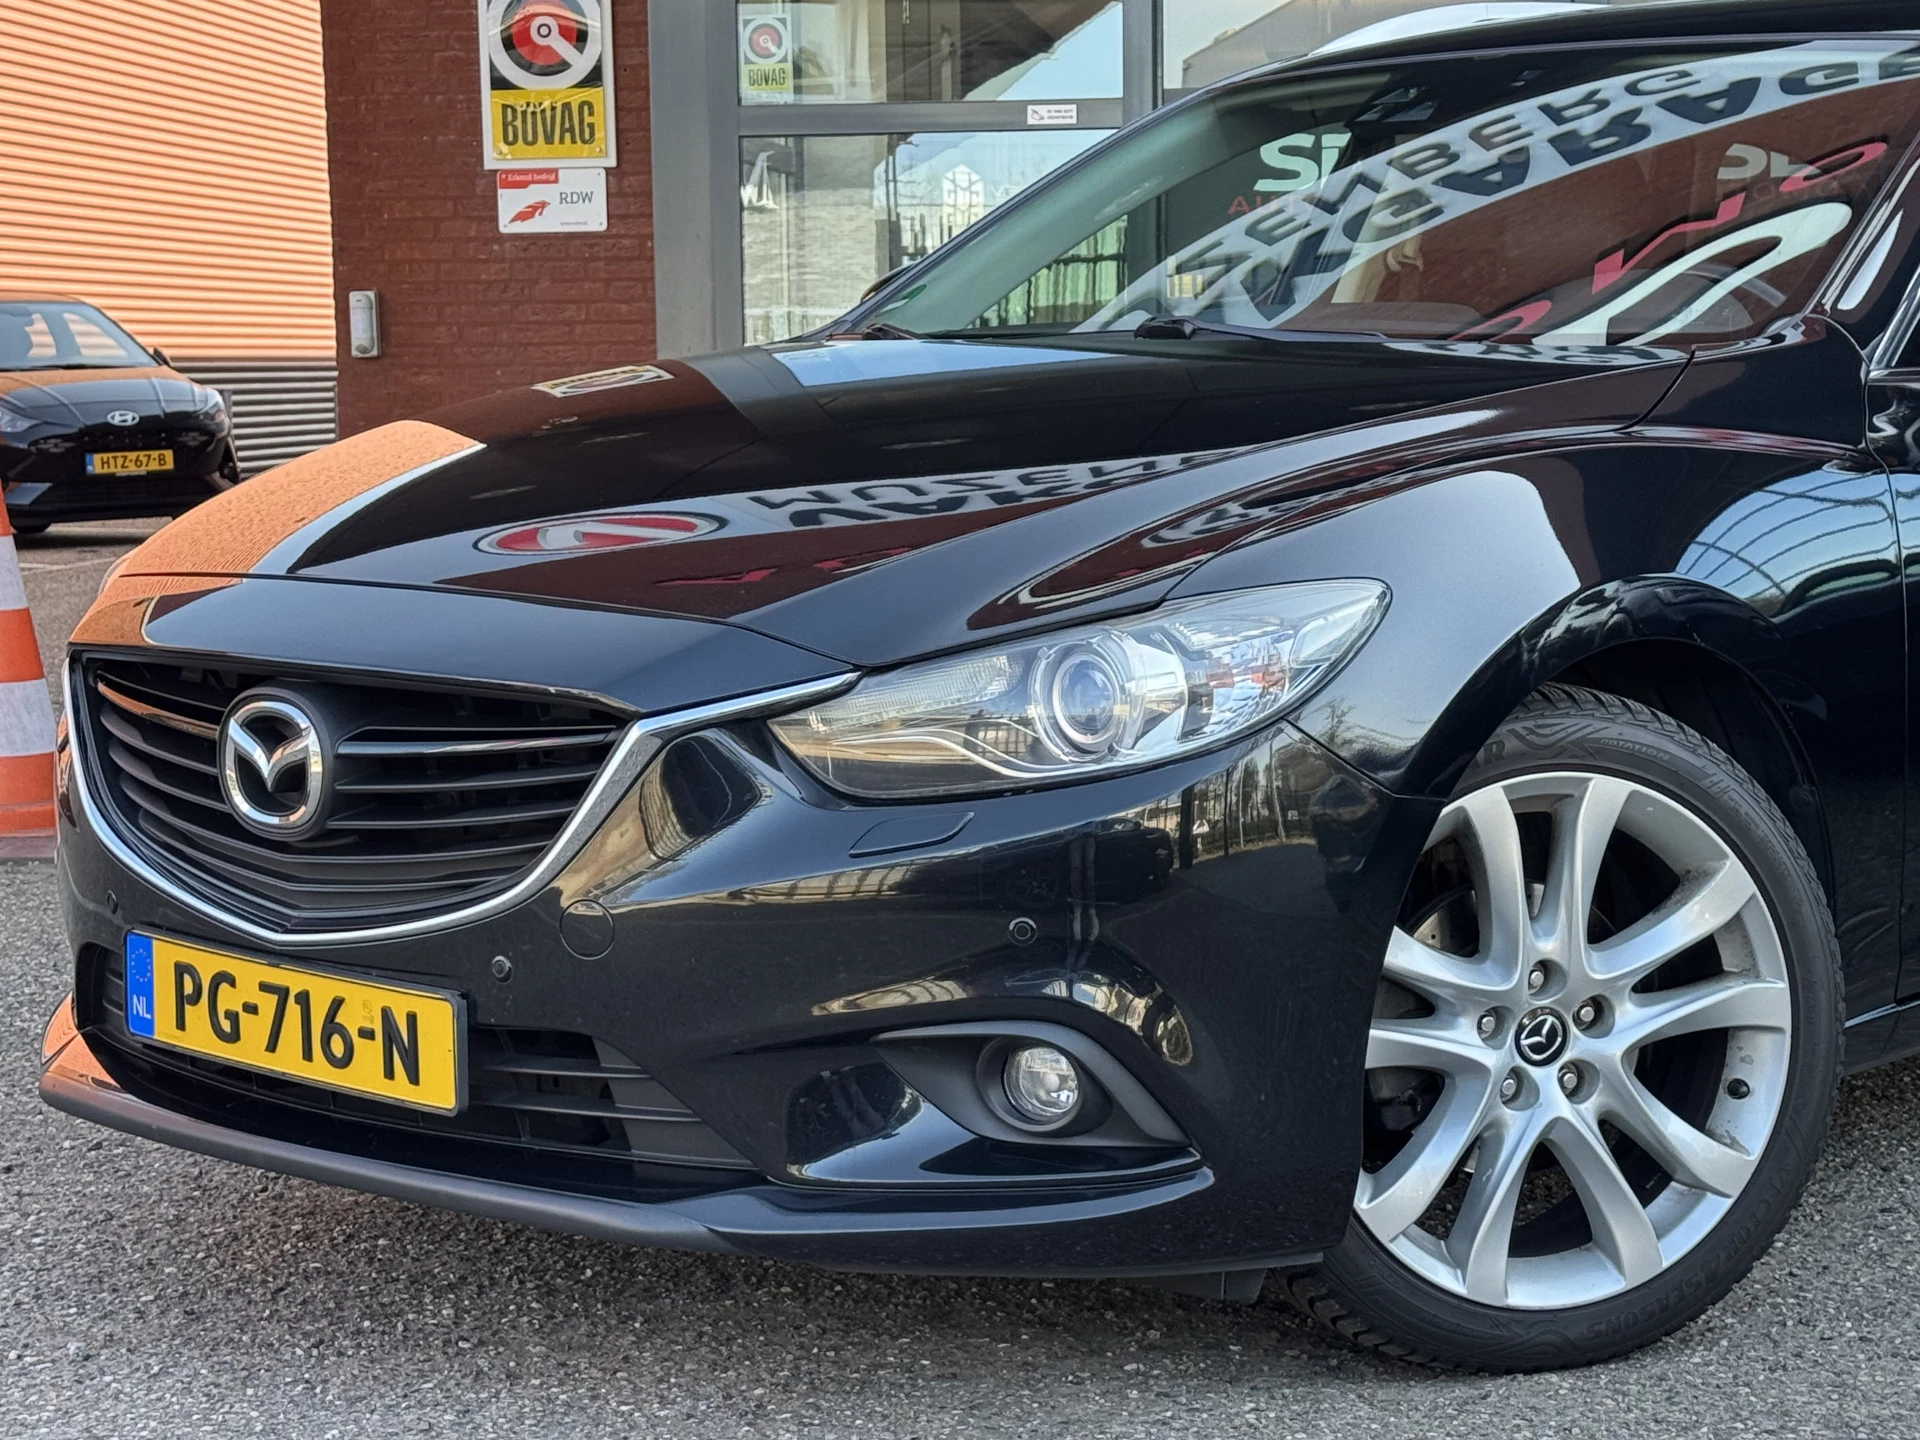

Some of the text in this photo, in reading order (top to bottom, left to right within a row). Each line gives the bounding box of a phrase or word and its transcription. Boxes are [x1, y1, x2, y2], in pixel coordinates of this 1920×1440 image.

[748, 68, 785, 86] BOVAG
[501, 99, 597, 147] BOVAG
[559, 191, 594, 205] RDW
[100, 453, 167, 470] HTZ-67-B
[132, 994, 151, 1019] NL
[173, 960, 420, 1086] PG-716-N
